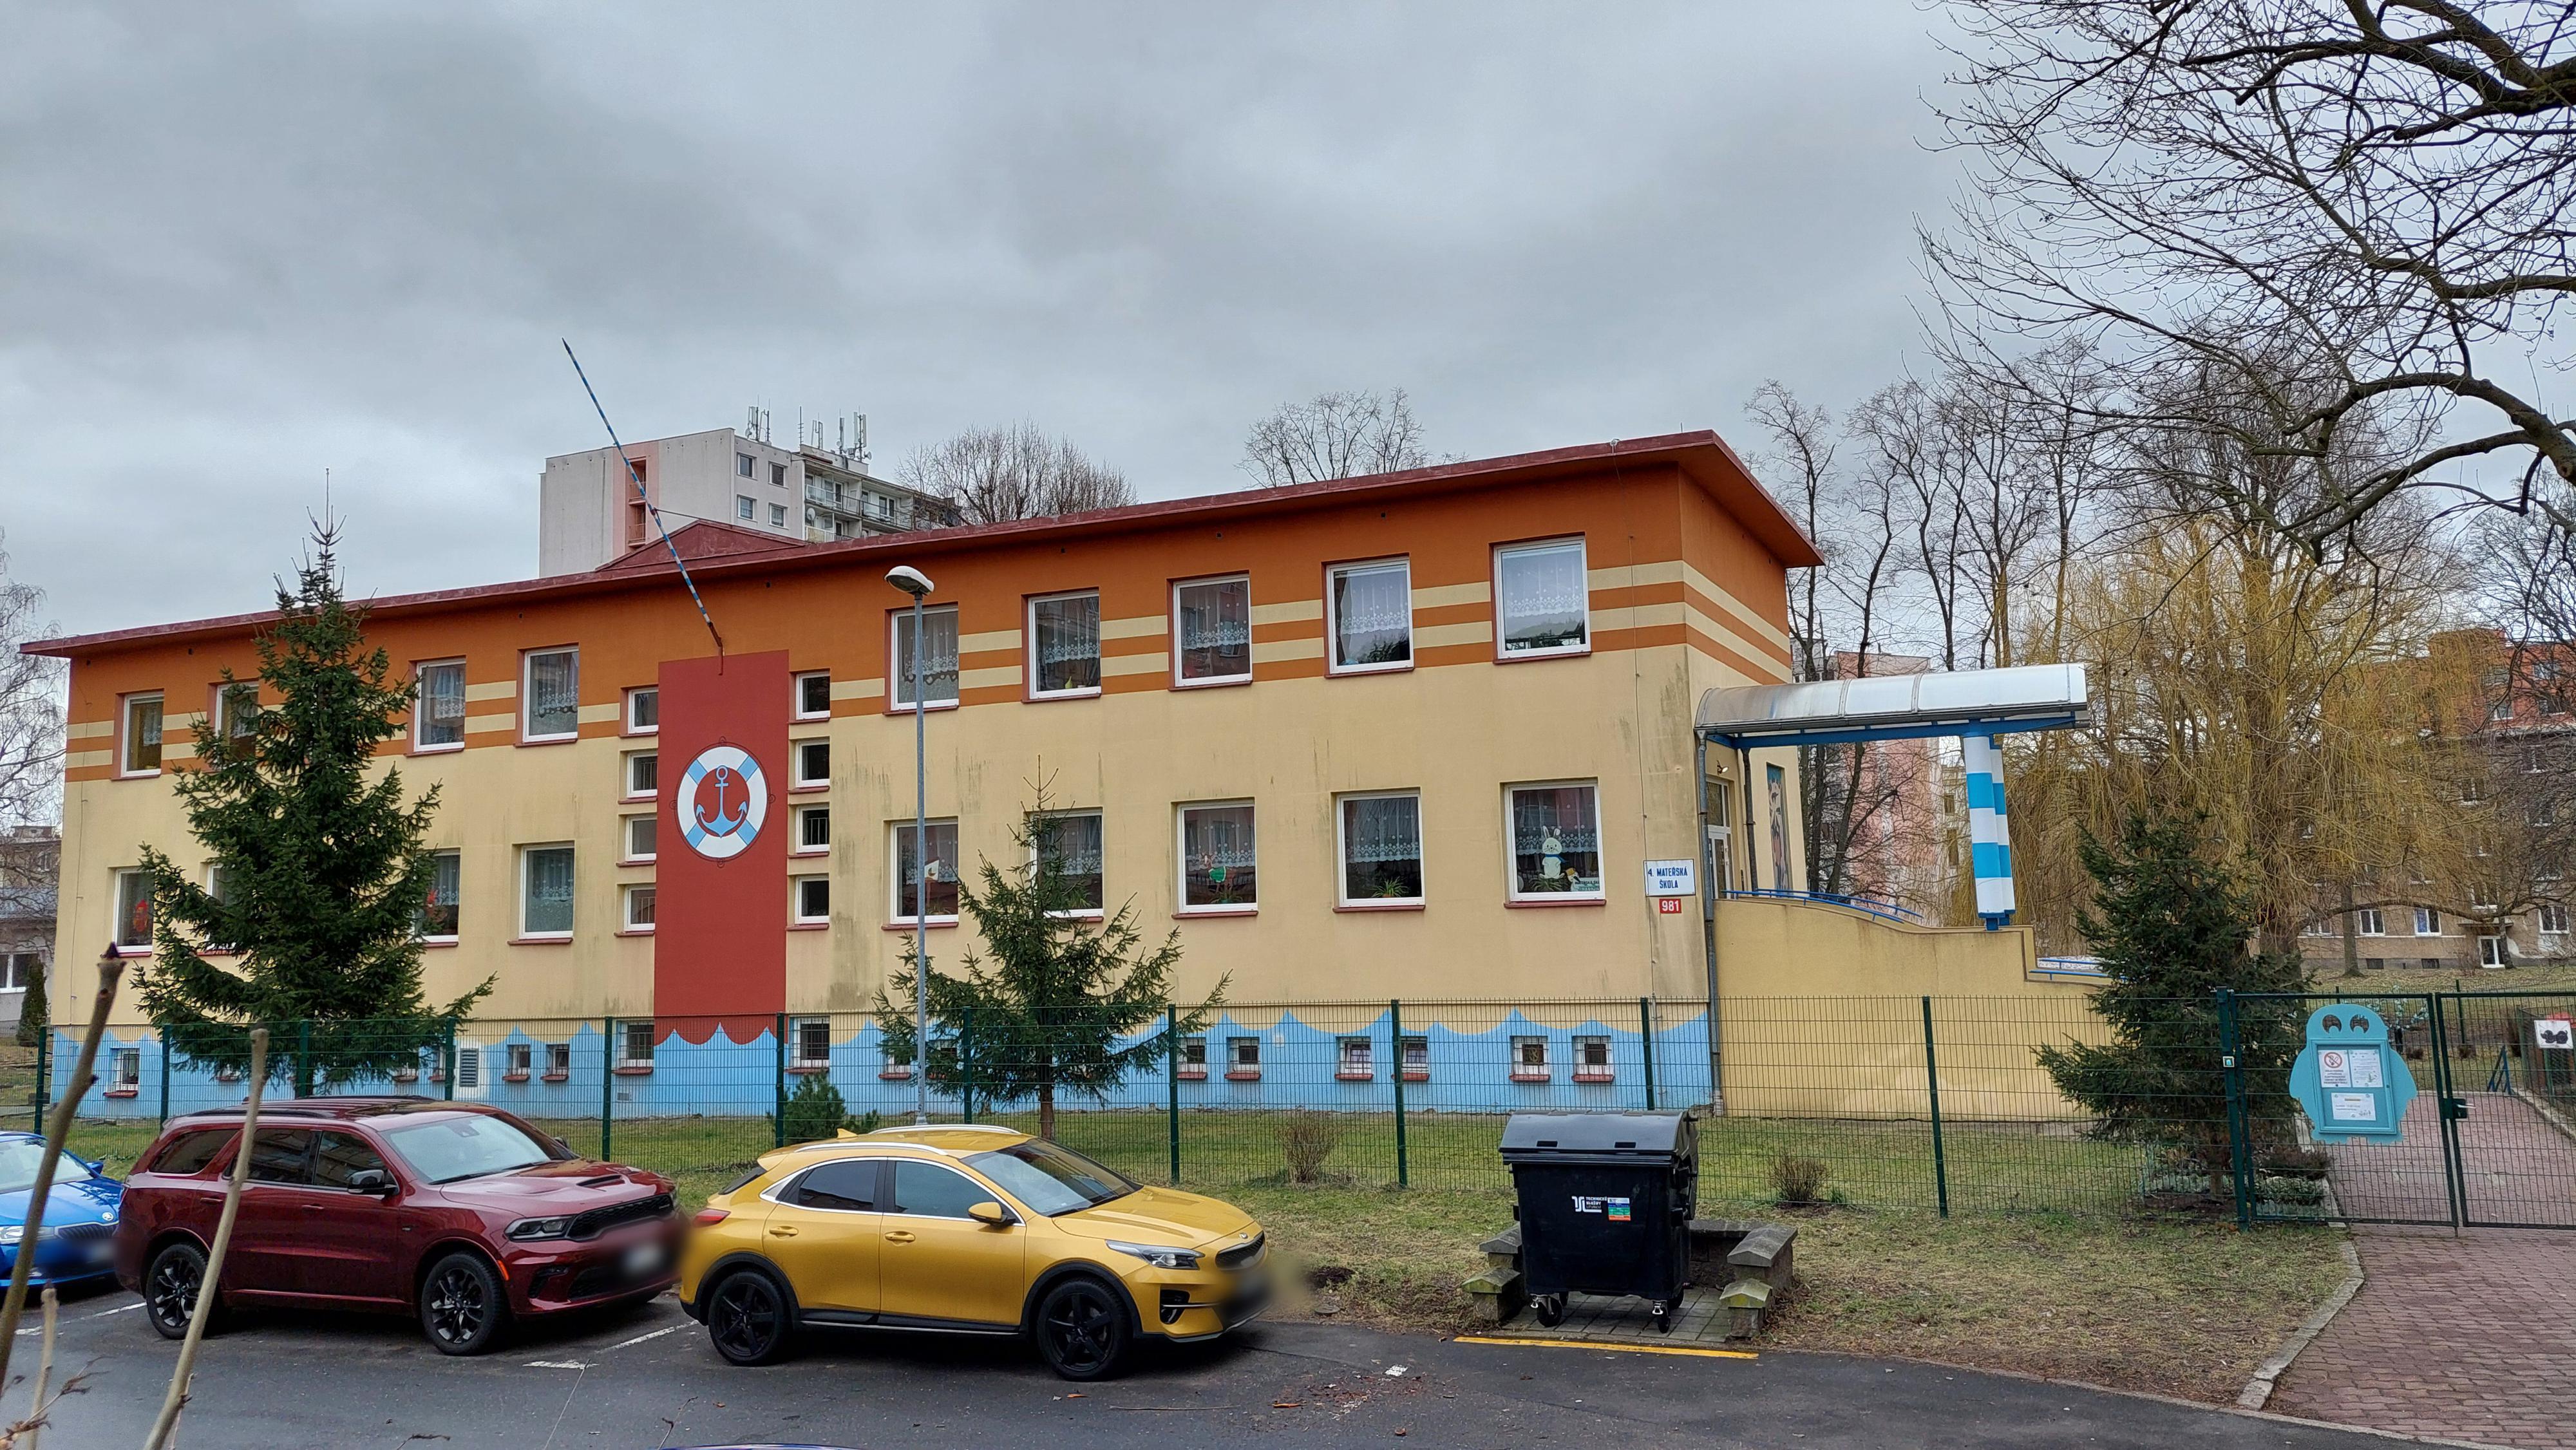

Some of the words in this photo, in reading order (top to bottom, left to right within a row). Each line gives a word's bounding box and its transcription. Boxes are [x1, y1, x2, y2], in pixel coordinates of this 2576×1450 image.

[1647, 868, 1654, 877] 4.
[1656, 866, 1688, 876] MATEŘSKÁ
[1659, 880, 1679, 889] ŠKOLA
[1662, 900, 1680, 912] 981
